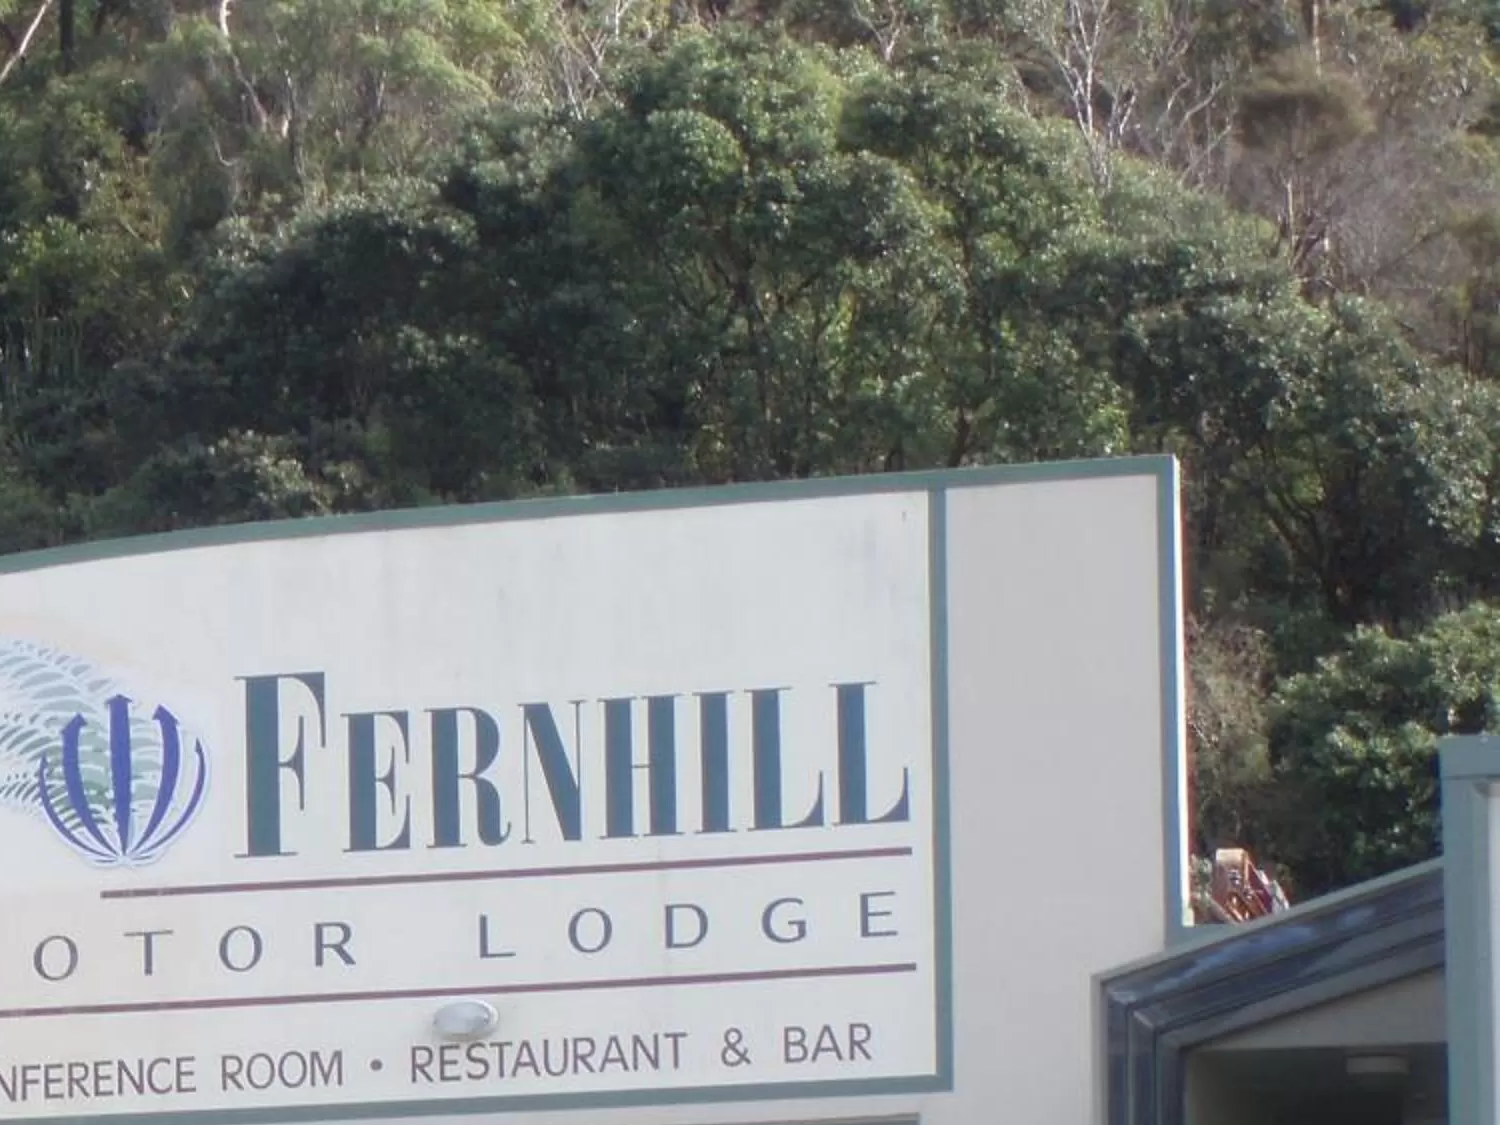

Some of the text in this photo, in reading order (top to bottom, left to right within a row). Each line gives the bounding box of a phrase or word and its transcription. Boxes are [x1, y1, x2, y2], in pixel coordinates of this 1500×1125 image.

[234, 670, 910, 860] FERNHILL
[478, 890, 900, 960] LODGE
[221, 1048, 344, 1092] ROOM
[409, 1031, 688, 1085] RESTAURANT
[721, 1027, 751, 1067] &
[782, 1021, 874, 1064] BAR
